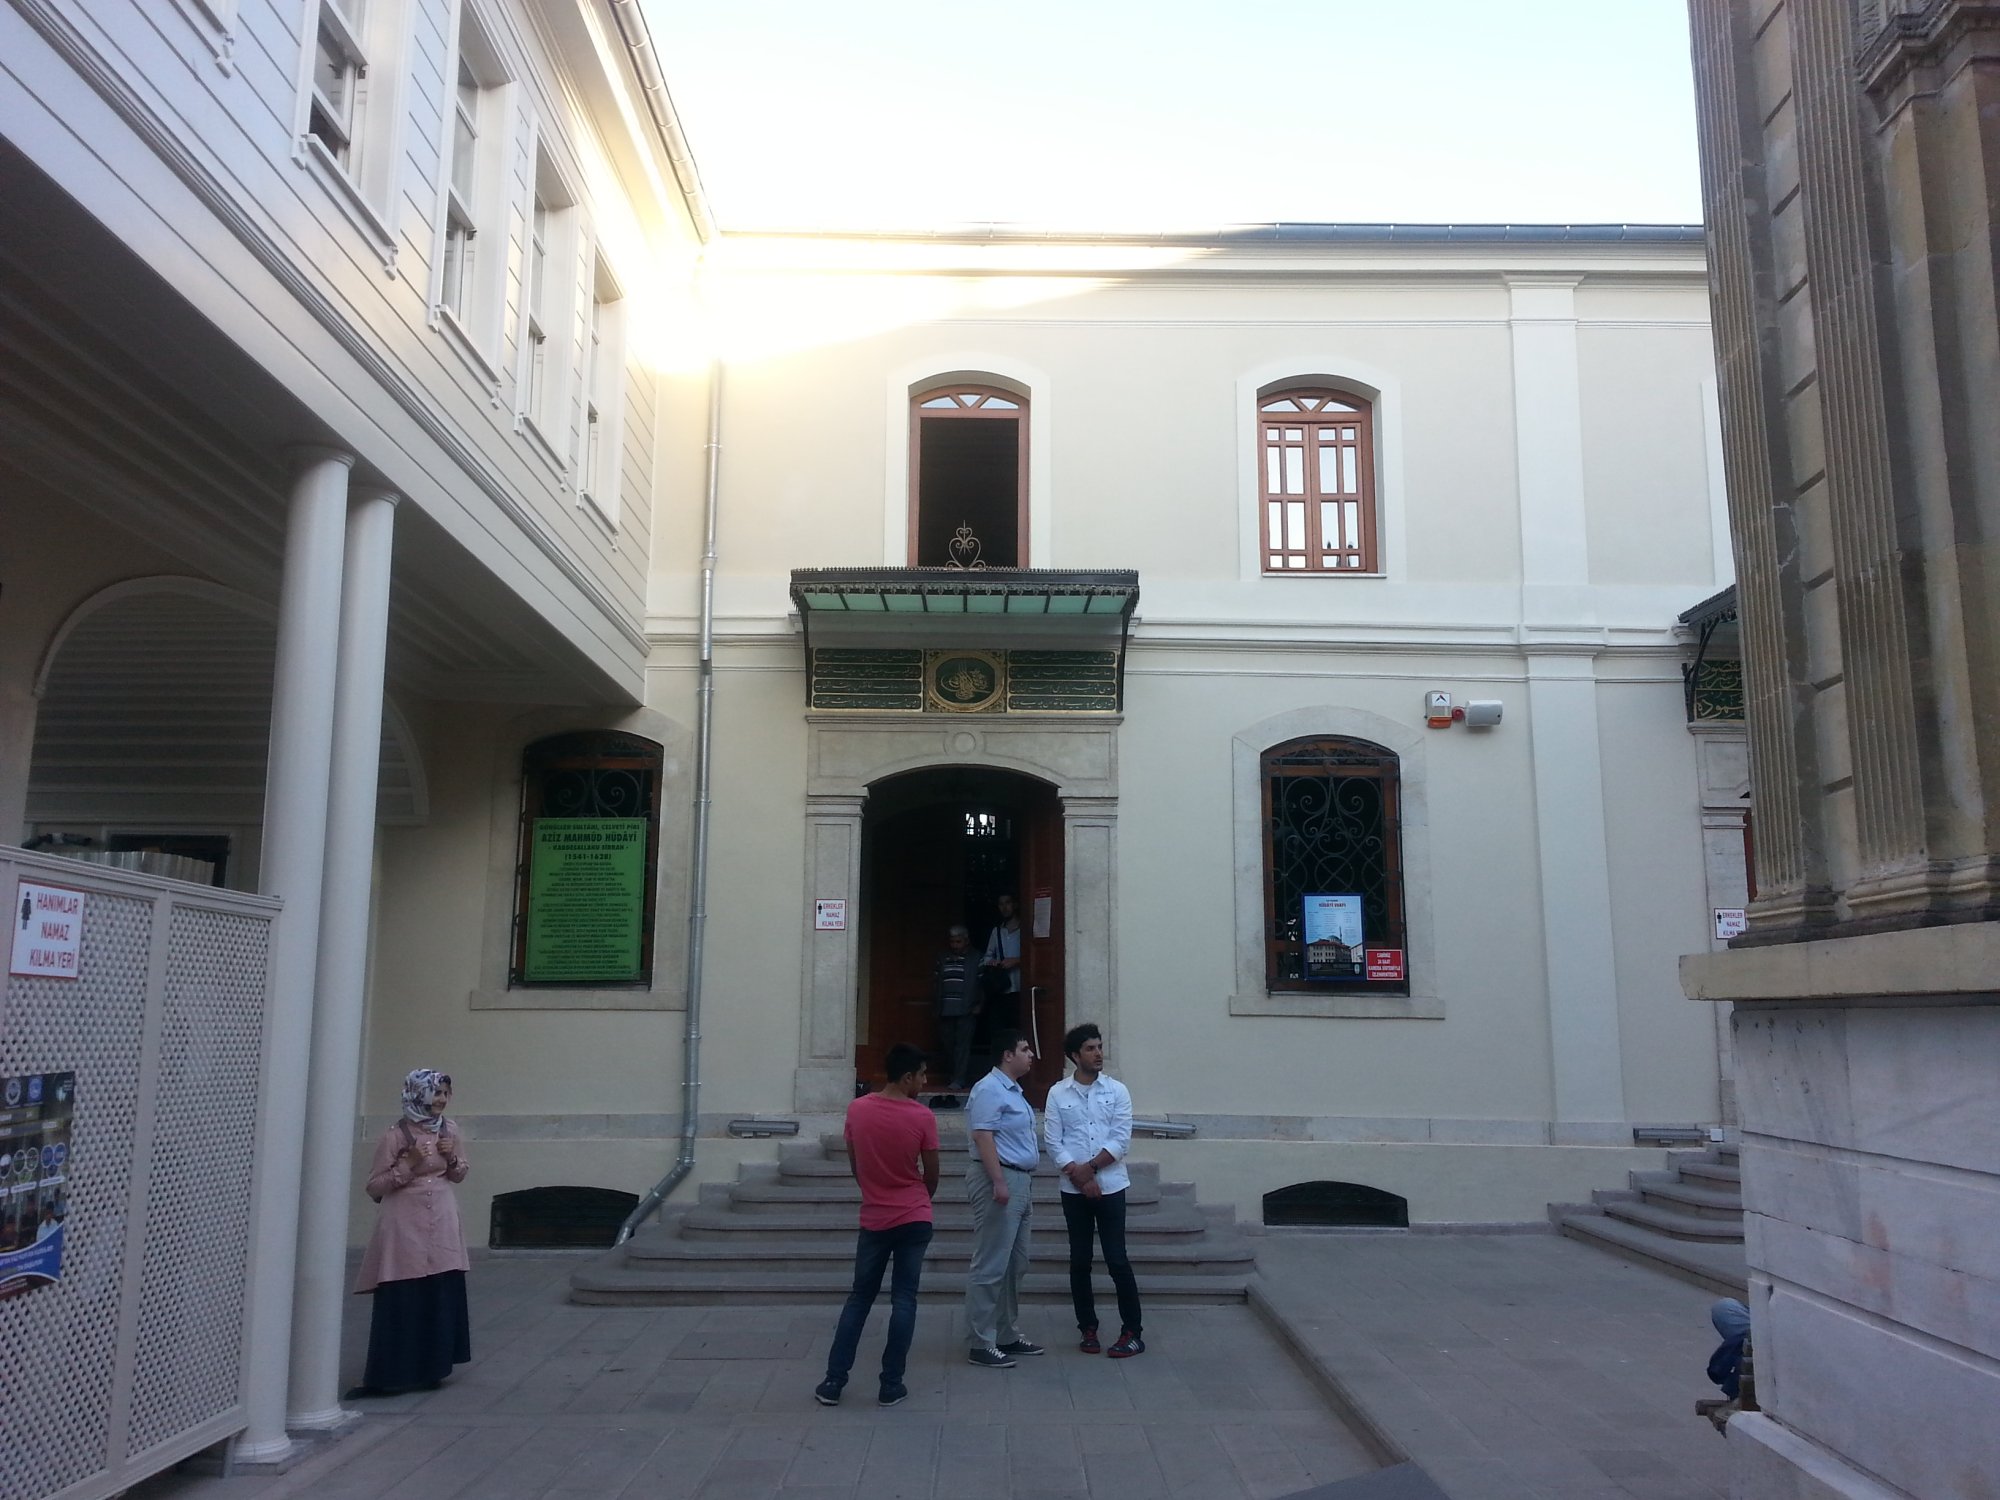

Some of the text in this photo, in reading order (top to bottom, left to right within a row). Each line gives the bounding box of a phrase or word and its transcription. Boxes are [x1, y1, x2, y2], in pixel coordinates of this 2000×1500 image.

[542, 831, 561, 842] AZİZ
[36, 892, 79, 915] HANIMLAR
[41, 921, 70, 941] NAMAZ
[29, 948, 76, 969] KILMA YERİ
